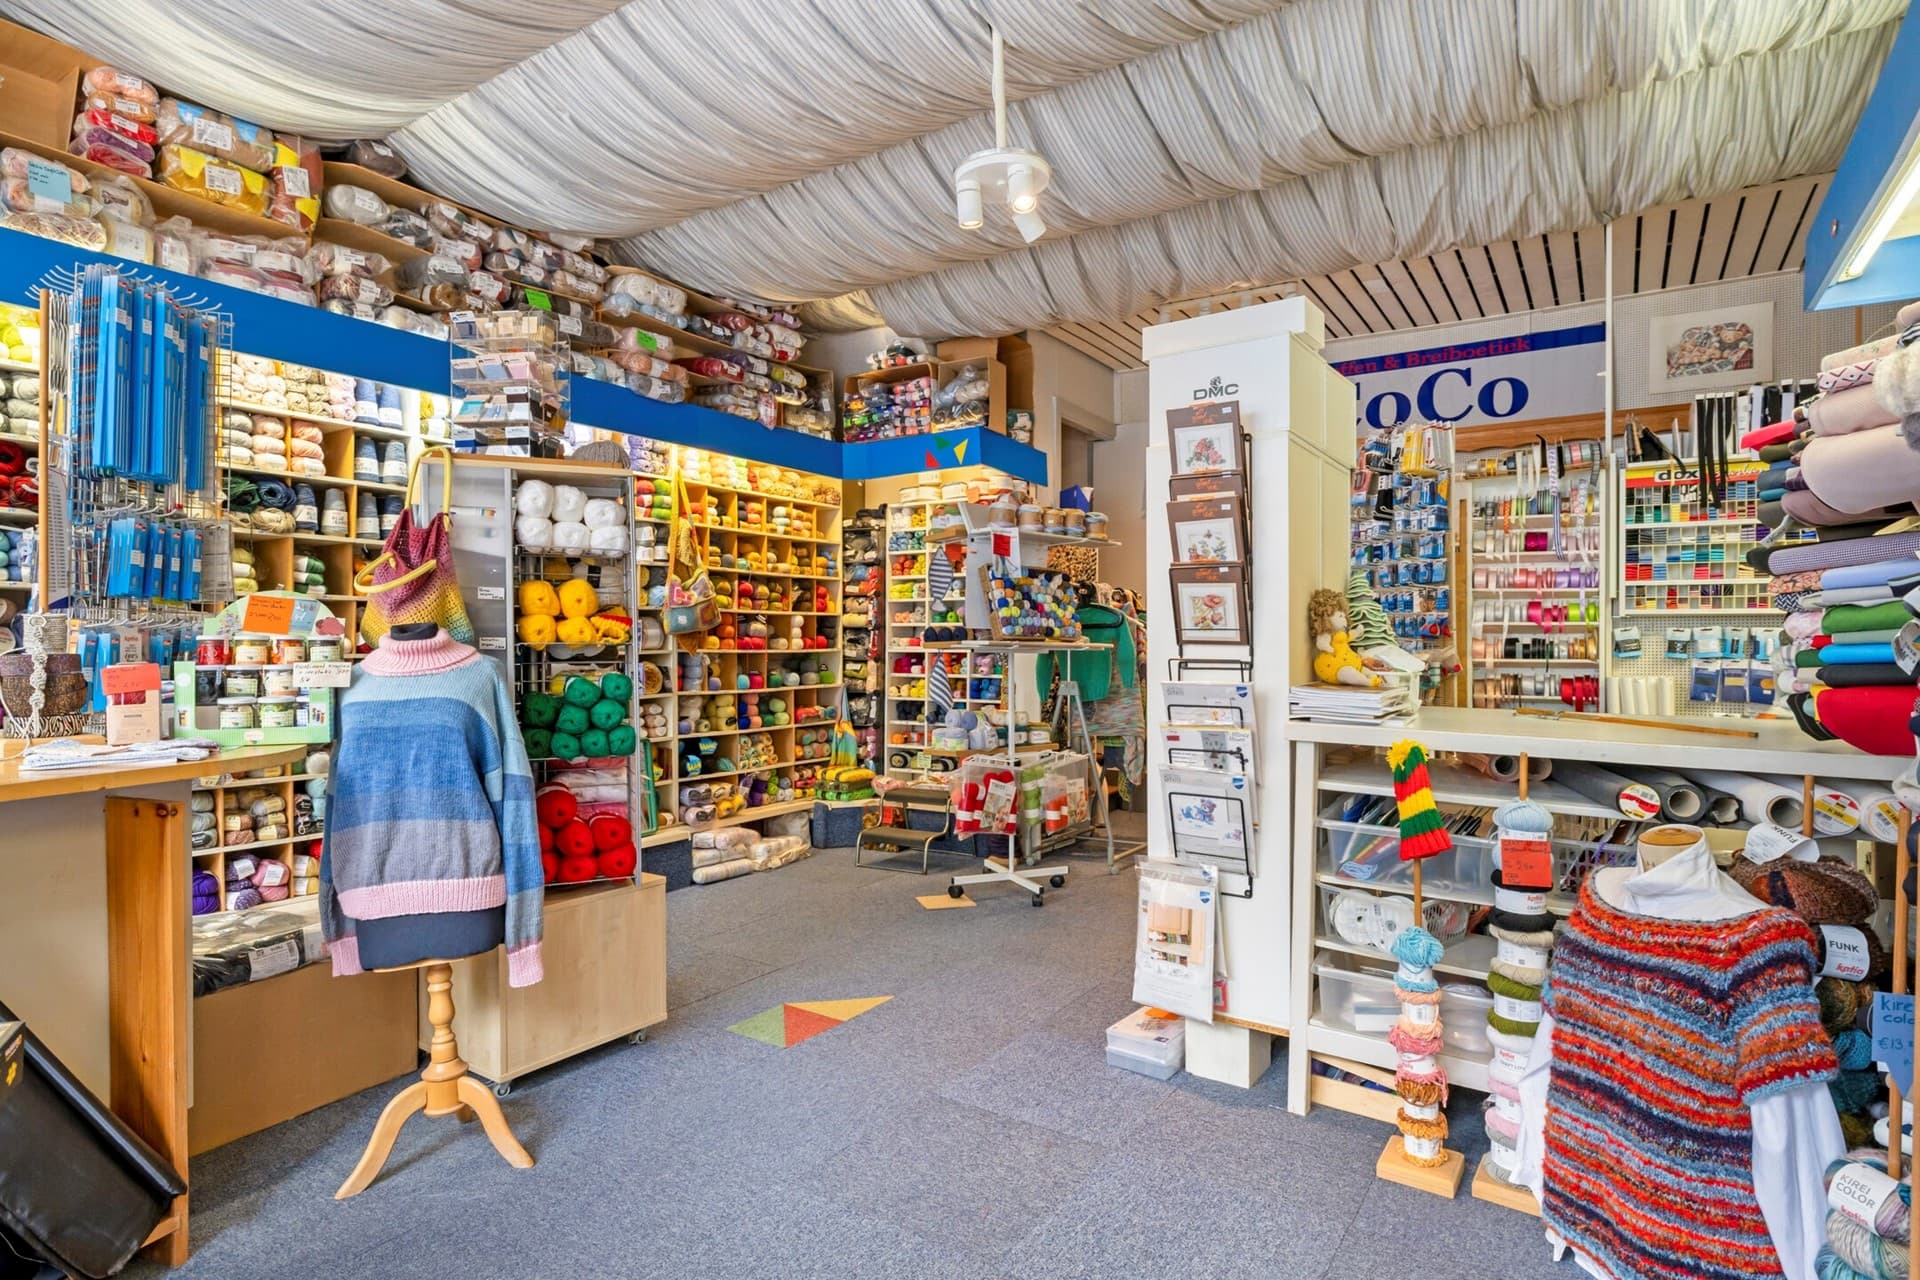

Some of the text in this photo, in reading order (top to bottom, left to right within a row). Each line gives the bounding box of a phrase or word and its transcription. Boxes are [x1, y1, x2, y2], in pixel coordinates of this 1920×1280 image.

[1335, 336, 1531, 377] ffen & Breiboetiek
[1193, 383, 1239, 401] DMC
[1356, 366, 1529, 430] oCo
[1771, 825, 1799, 844] FUNK
[1829, 940, 1860, 953] FUNK
[1881, 994, 1914, 1013] kire
[1882, 1013, 1914, 1025] colo
[1840, 1173, 1872, 1196] KIREI
[1835, 1181, 1877, 1209] COLOR
